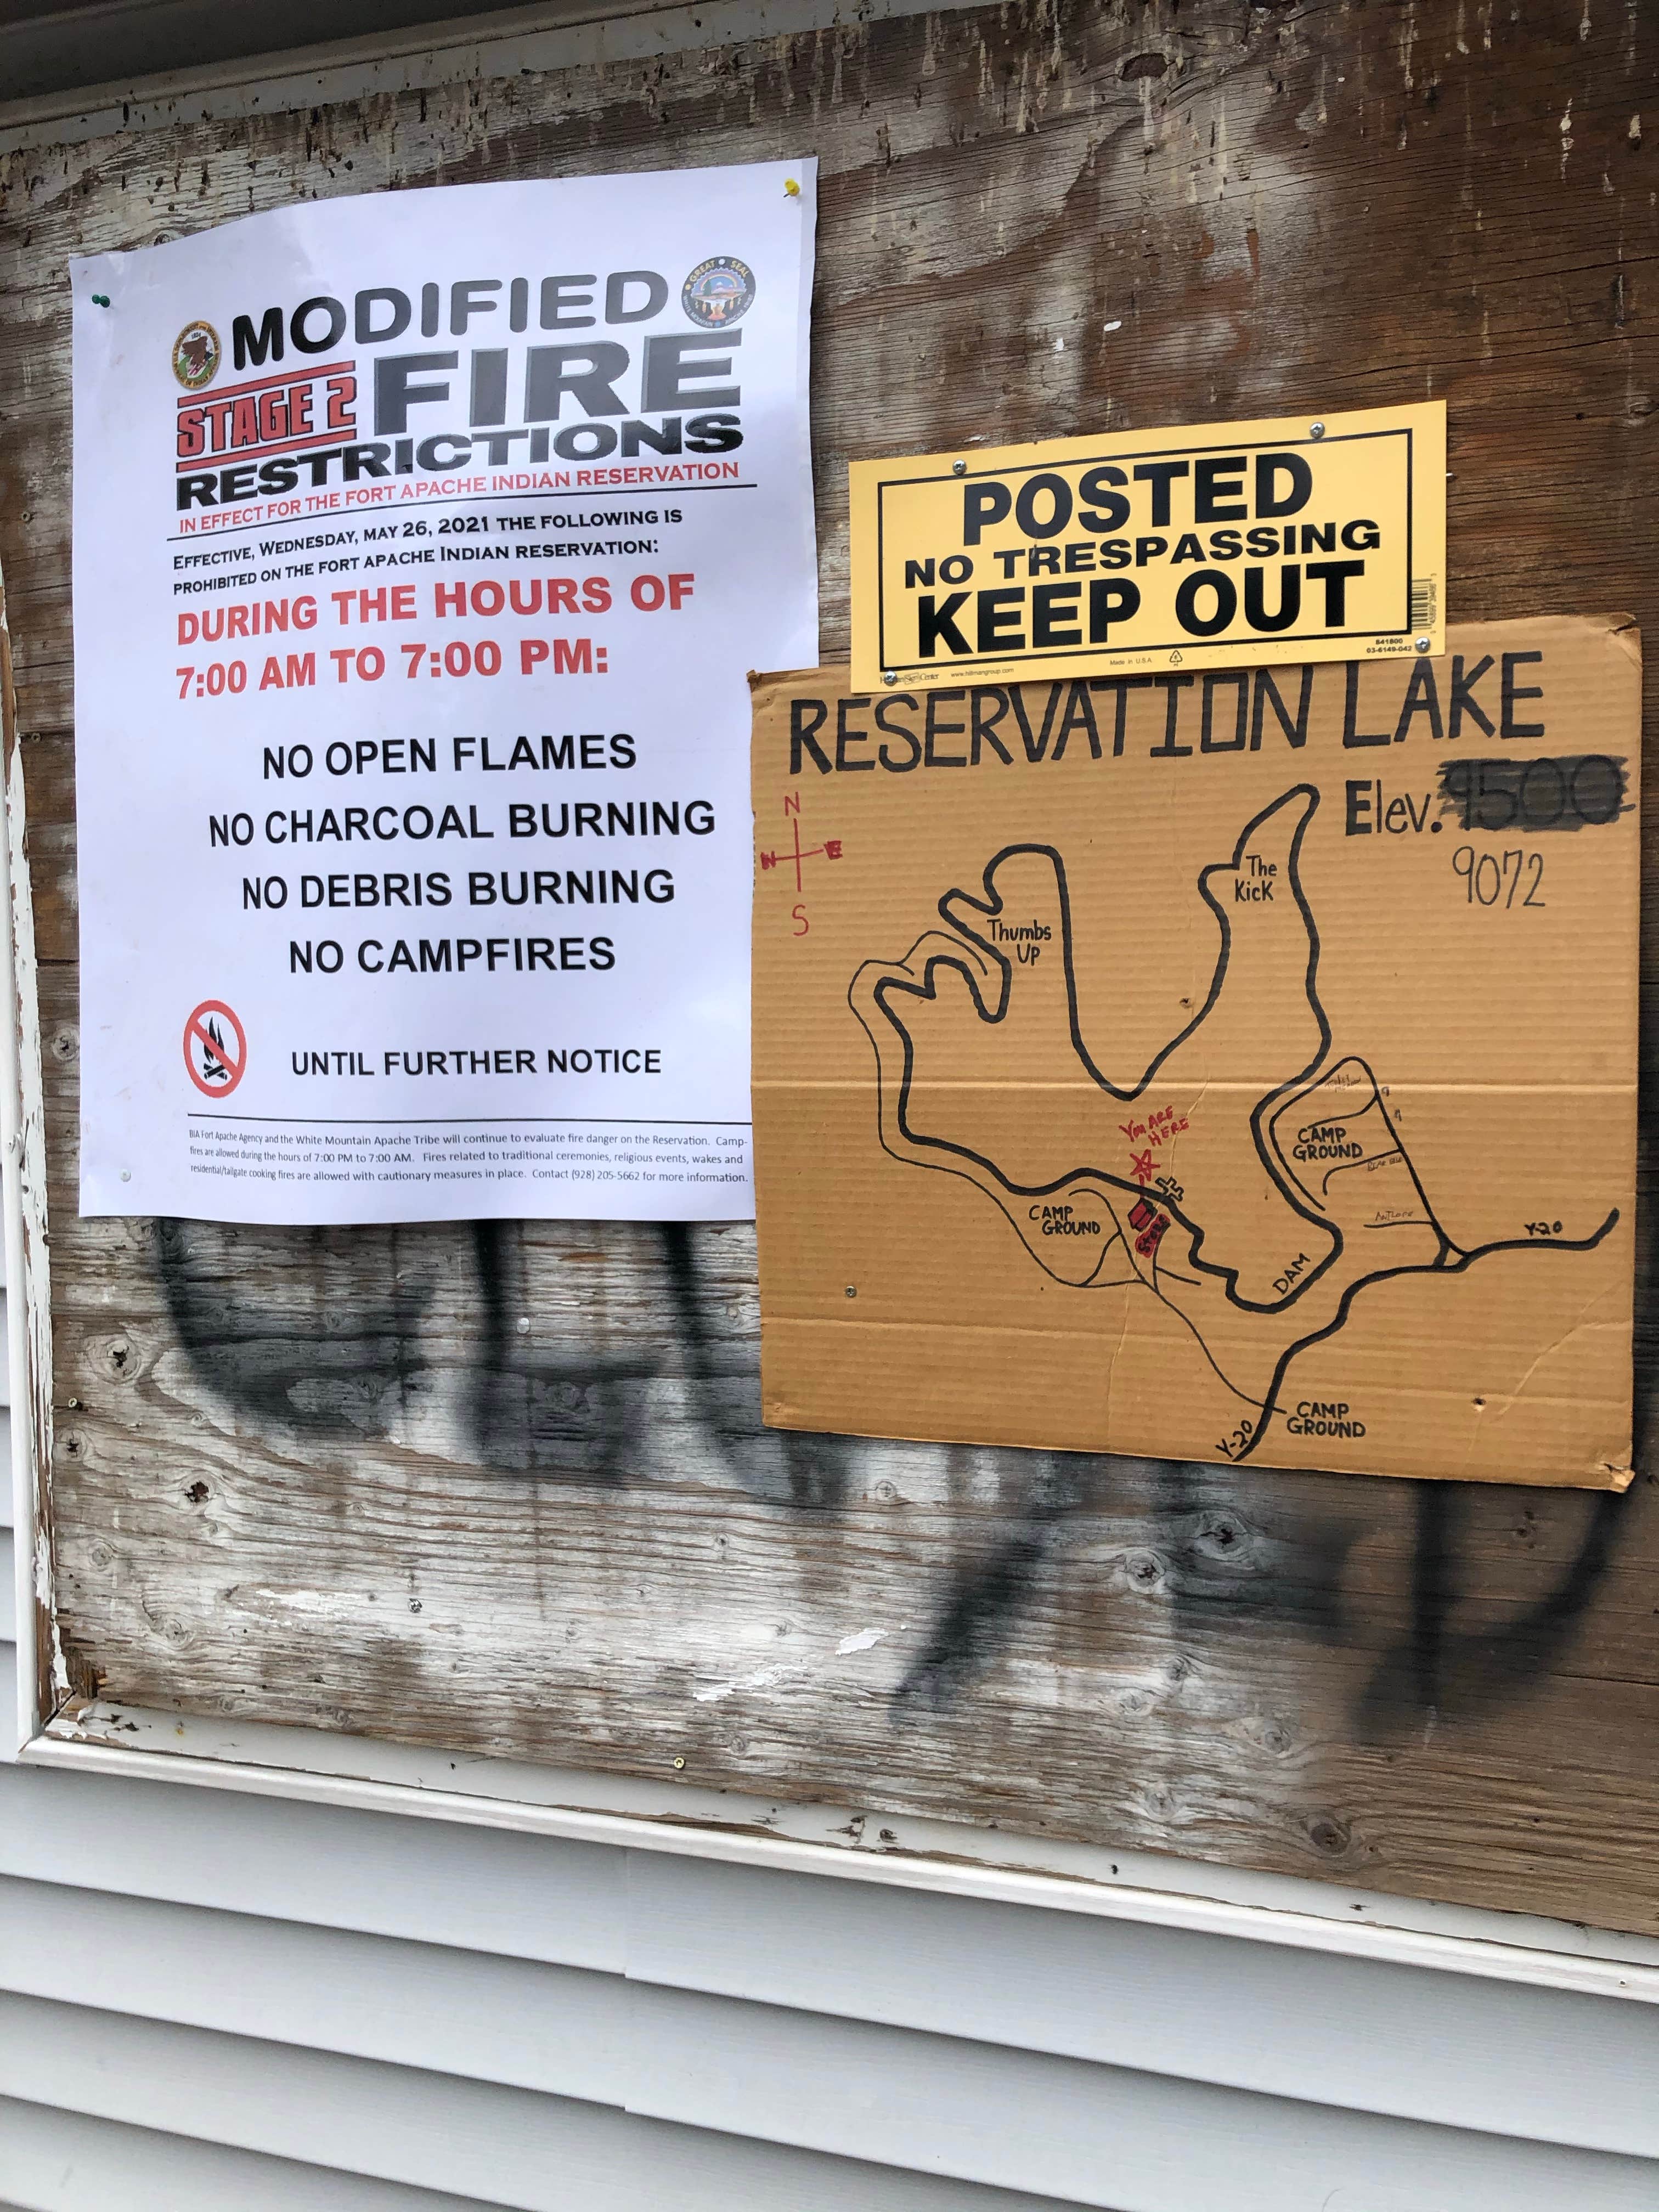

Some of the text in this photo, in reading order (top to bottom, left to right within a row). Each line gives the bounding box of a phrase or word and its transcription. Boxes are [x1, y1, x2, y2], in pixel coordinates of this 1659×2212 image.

[690, 260, 749, 281] GREAT SEAL
[233, 270, 669, 371] MODIFIED
[373, 328, 743, 436] FIRE
[177, 376, 357, 458] STAGE 2
[176, 413, 744, 511] RESTRICTIONS
[180, 462, 740, 534] IN EFFECT FOR THE FORT APACHE INDIAN RESERVATION
[963, 452, 1313, 547] POSTED
[364, 525, 399, 541] MAY
[402, 521, 432, 538] 26,
[438, 516, 489, 534] 2021
[496, 515, 536, 531] THE
[541, 510, 658, 529] FOLLOWING
[664, 509, 683, 523] IS
[173, 539, 659, 595] PROHIBITED ON THE FORT APACHE INDIAN RESERVATION:
[905, 518, 1381, 590] NO TRESPASSING
[177, 573, 695, 646] DURING THE HOURS OF
[917, 578, 1141, 658] KEEP
[1175, 559, 1365, 637] OUT
[176, 637, 609, 700] 7:00 AM TO 7:00 PM:
[789, 651, 1544, 775] RESERVATION LAKE
[263, 734, 637, 780] NO OPEN FLAMES
[210, 799, 716, 848] NO CHARCOAL BURNING
[785, 792, 801, 816] N
[1345, 778, 1443, 837] Elev.
[1245, 855, 1278, 877] The
[1452, 845, 1546, 909] 9072
[242, 868, 675, 910] NO DEBRIS BURNING
[792, 904, 809, 936] S
[986, 918, 1052, 943] Thumbs
[289, 937, 617, 974] NO CAMPFIRES
[291, 1048, 662, 1076] UNTIL FURTHER NOTICE
[189, 1129, 200, 1139] BIA
[201, 1130, 214, 1139] Fort
[215, 1131, 238, 1142] Apache
[239, 1133, 263, 1145] Agency
[264, 1135, 279, 1144] and
[280, 1135, 294, 1144] the
[296, 1135, 323, 1145] White
[325, 1136, 371, 1146] Mountain
[374, 1136, 411, 1147] Apache
[414, 1135, 440, 1145] Tribe
[443, 1134, 461, 1144] will
[464, 1134, 507, 1143] continue
[511, 1135, 521, 1143] to
[524, 1133, 565, 1143] evaluate
[568, 1133, 584, 1143] fire
[586, 1134, 618, 1146] danger
[635, 1135, 650, 1144] the
[653, 1135, 711, 1146] Reservation.
[715, 1137, 748, 1149] Camp-
[1148, 1117, 1190, 1147] HERE
[1292, 1142, 1363, 1161] GROUND
[1298, 1126, 1347, 1145] CAMP
[190, 1146, 204, 1156] fires
[216, 1148, 239, 1159] allowed
[241, 1150, 262, 1163] during
[264, 1152, 276, 1161] the
[278, 1152, 301, 1163] hours
[303, 1152, 312, 1163] of
[314, 1153, 335, 1163] 7:00
[338, 1154, 353, 1163] PM
[356, 1154, 366, 1163] to
[368, 1154, 391, 1163] 7:00
[393, 1153, 415, 1163] AM.
[423, 1152, 447, 1163] Fires
[449, 1152, 486, 1161] related
[488, 1152, 499, 1161] to
[501, 1150, 553, 1161] traditional
[556, 1152, 612, 1163] ceremonies,
[614, 1152, 653, 1164] religious
[655, 1154, 690, 1164] events,
[692, 1154, 722, 1164] wakes
[724, 1154, 743, 1164] and
[190, 1164, 247, 1178] residential/tailgate
[249, 1170, 276, 1181] cooking
[278, 1170, 295, 1180] fires
[313, 1171, 350, 1181] allowed
[352, 1171, 375, 1181] with
[377, 1170, 431, 1182] cautionary
[433, 1171, 483, 1180] measures
[485, 1169, 494, 1178] in
[497, 1169, 527, 1181] place.
[532, 1169, 569, 1179] Contact
[571, 1170, 595, 1181] (928)
[597, 1170, 640, 1181] 205-5662
[642, 1171, 656, 1181] for
[658, 1173, 685, 1182] more
[686, 1172, 749, 1183] information.
[1029, 1205, 1074, 1222] CAMP
[1042, 1217, 1101, 1236] GROUND
[1272, 1252, 1310, 1295] DAM
[1286, 1417, 1366, 1439] GROUND
[1297, 1401, 1350, 1419] CAMP
[1215, 1419, 1253, 1458] Y-20
